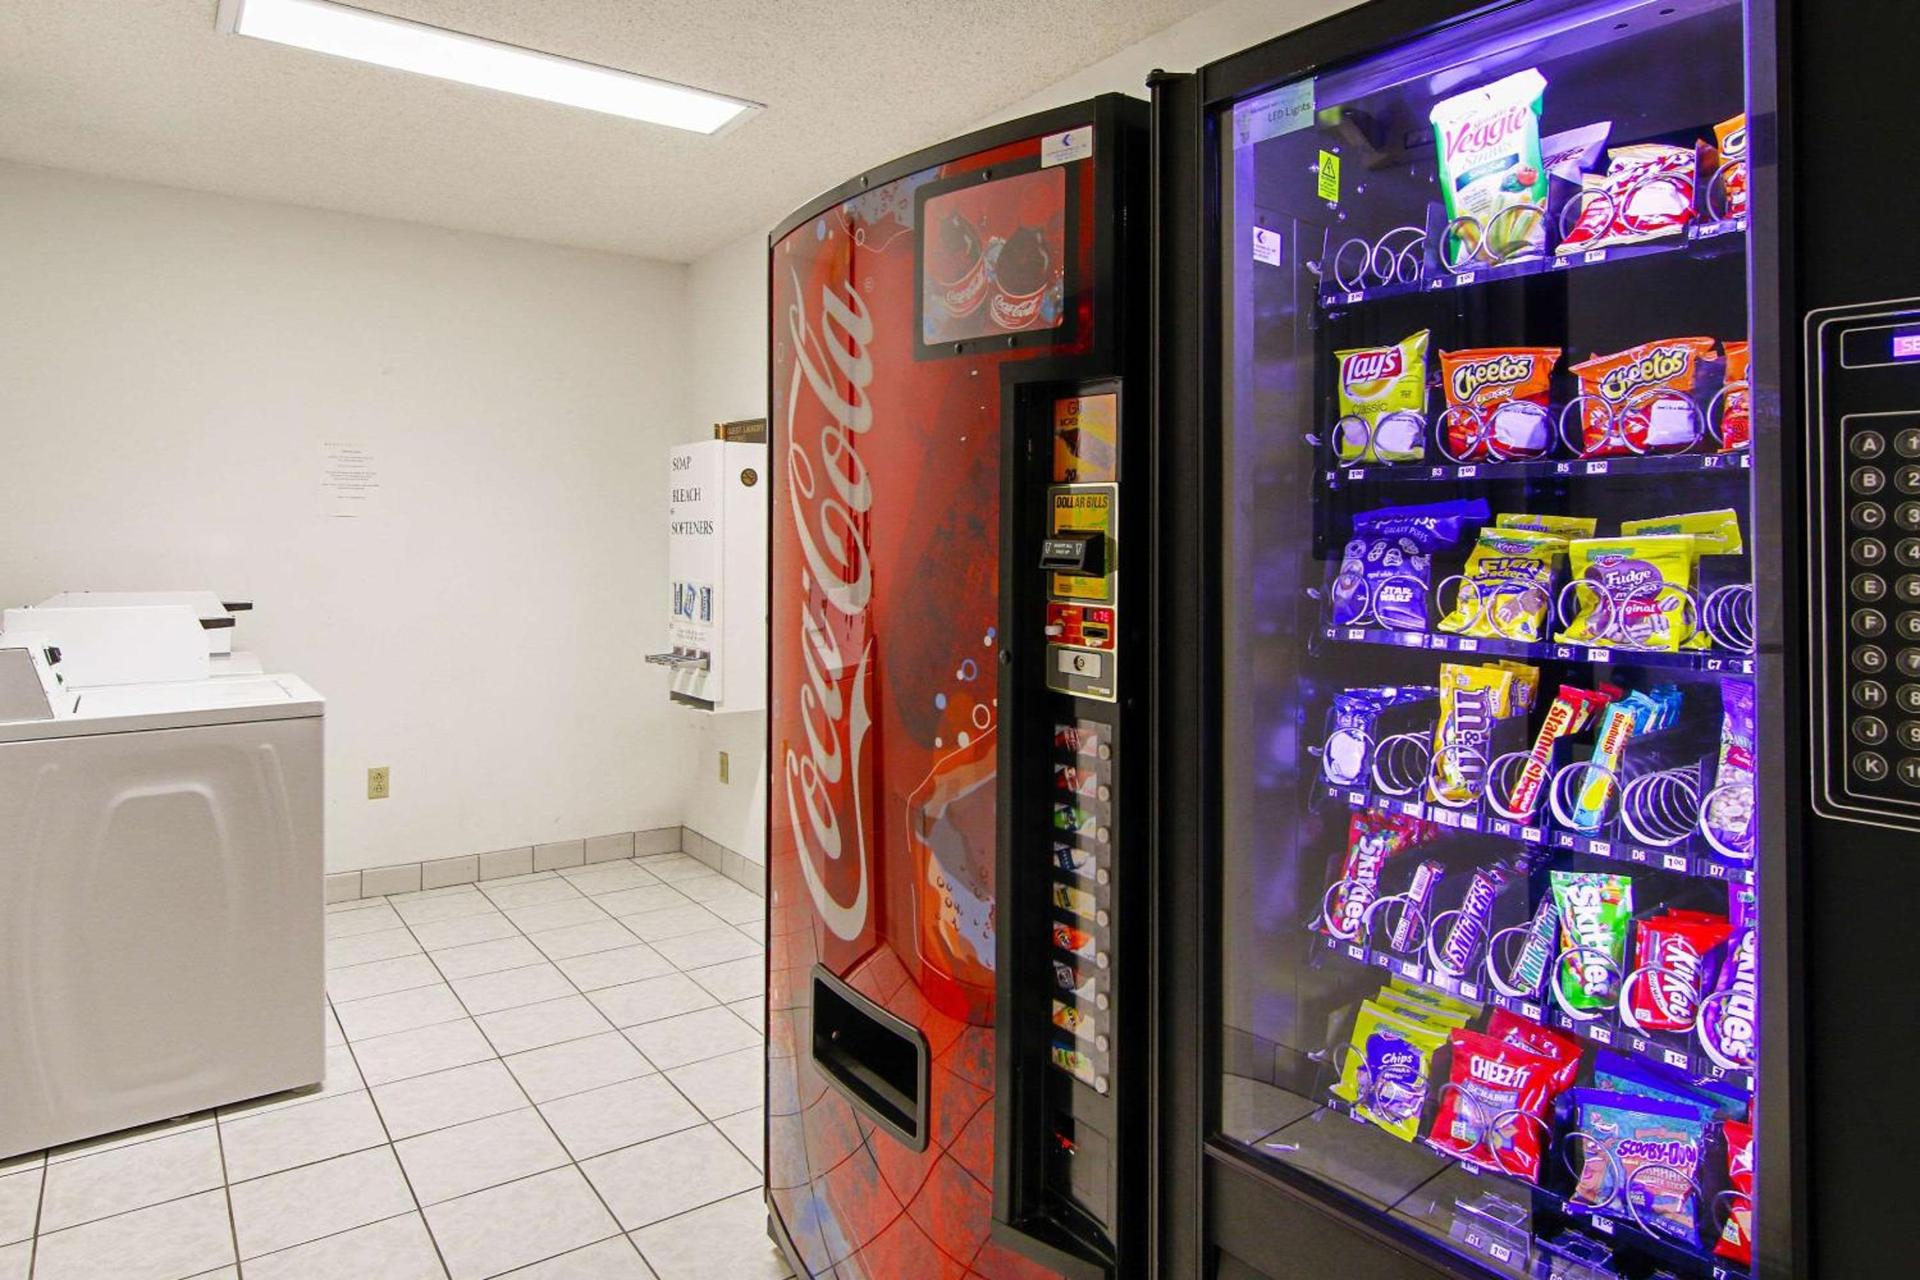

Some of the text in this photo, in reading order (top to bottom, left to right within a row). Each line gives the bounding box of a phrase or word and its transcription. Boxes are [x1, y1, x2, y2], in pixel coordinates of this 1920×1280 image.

[1446, 105, 1527, 162] Veggie
[1554, 258, 1567, 268] A5
[1431, 279, 1443, 289] A3
[1455, 355, 1531, 401] Cheetos
[1601, 349, 1687, 400] Cheetos
[1862, 438, 1877, 451] A
[1909, 437, 1919, 450] 1
[672, 456, 692, 471] SOAP
[1705, 456, 1719, 466] B7
[1557, 464, 1569, 472] B5
[1862, 474, 1877, 487] B
[1909, 473, 1920, 486] 2
[672, 488, 701, 503] BLEACH
[1056, 495, 1108, 509] DOLLAR BILLS
[1862, 509, 1877, 523] C
[1909, 509, 1920, 523] 3
[671, 520, 714, 535] SOFTENERS
[1863, 545, 1877, 558] D
[1909, 545, 1920, 558] 4
[1606, 569, 1652, 586] Fudge
[1383, 586, 1412, 595] STAR
[1864, 581, 1877, 594] E
[1909, 582, 1920, 595] 5
[787, 265, 875, 942] Coca-Cola
[1380, 592, 1414, 602] WARS
[1864, 616, 1877, 629] F
[1910, 618, 1920, 632] 6
[1557, 649, 1570, 658] C5
[1863, 652, 1878, 665] G
[1707, 659, 1722, 670] C7
[1864, 688, 1879, 701] H
[1866, 724, 1877, 737] J
[1865, 759, 1879, 772] K
[1561, 835, 1574, 847] D5
[1632, 849, 1646, 860] D6
[1709, 864, 1724, 876] D7
[1446, 878, 1495, 964] SNICKERS
[1566, 885, 1613, 996] Skittles
[1561, 1017, 1573, 1029] E5
[1633, 1038, 1646, 1051] E6
[1381, 1052, 1414, 1065] Chips
[1711, 1065, 1725, 1077] E7
[1713, 1265, 1727, 1280] F7
